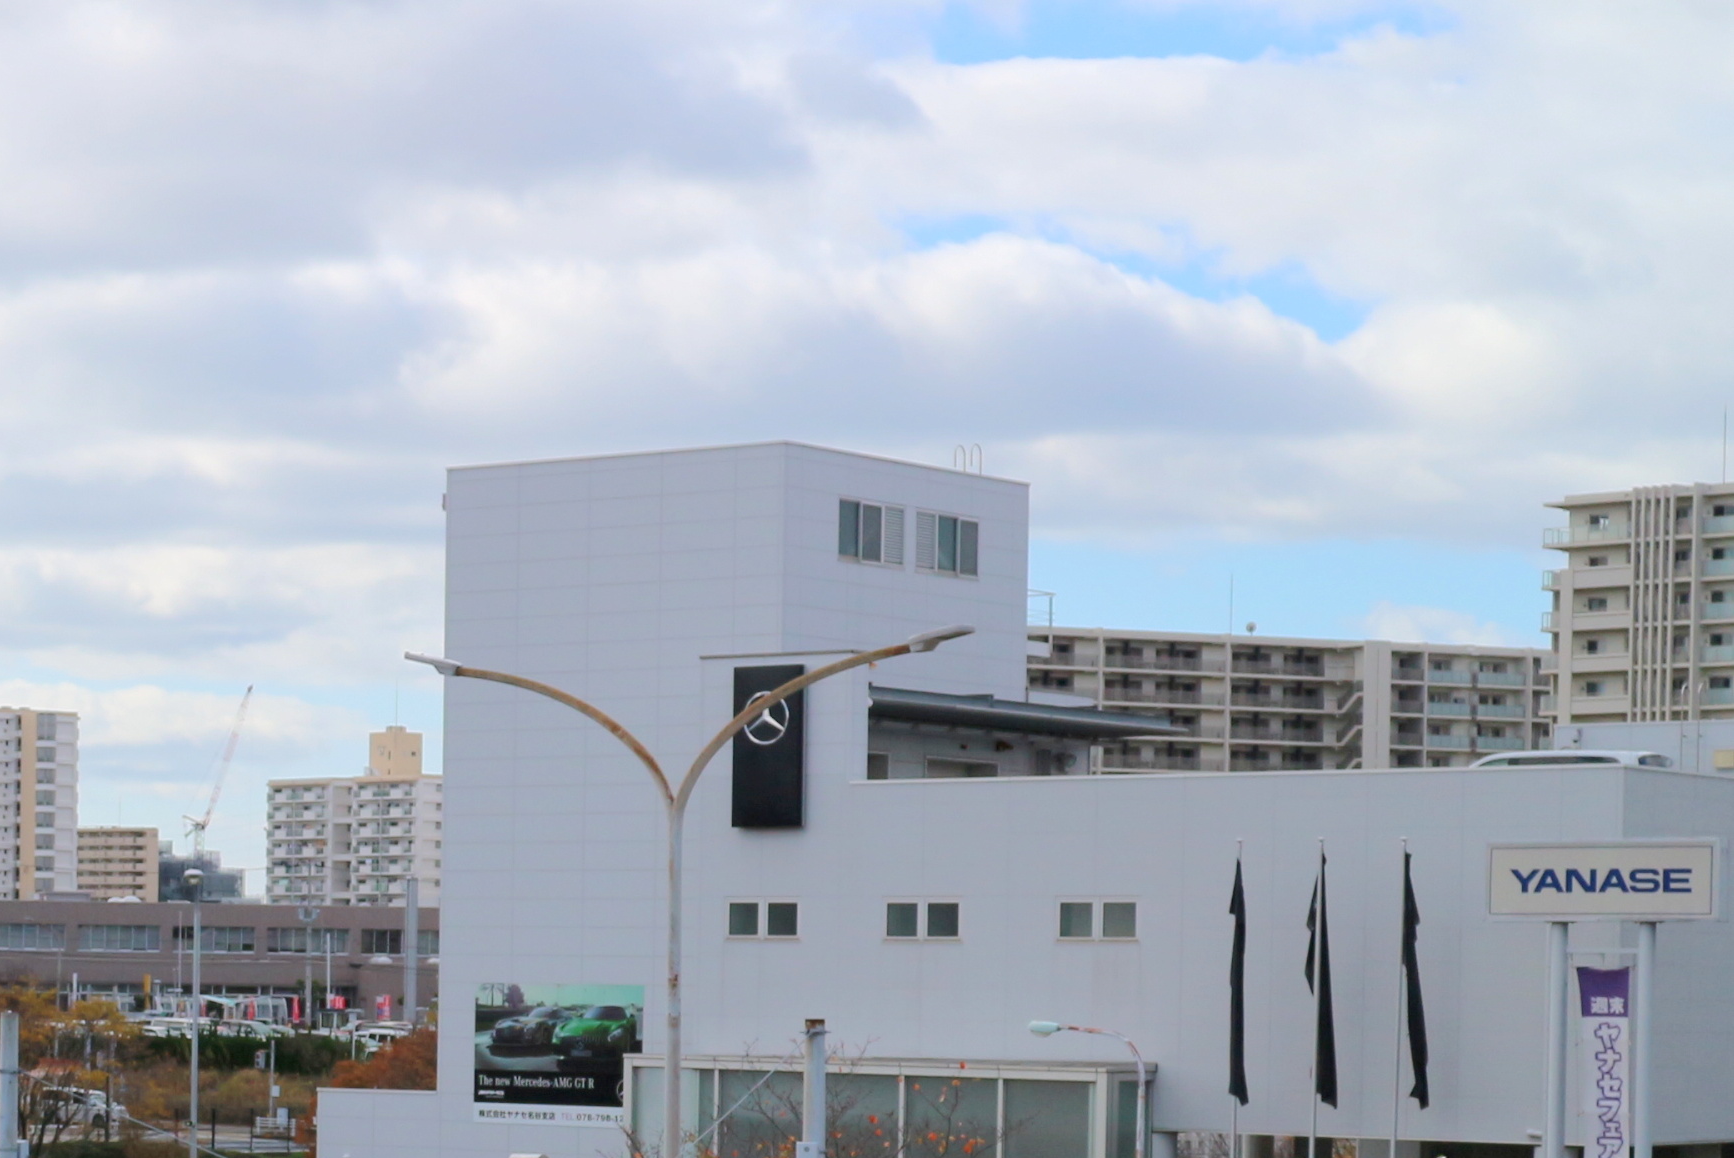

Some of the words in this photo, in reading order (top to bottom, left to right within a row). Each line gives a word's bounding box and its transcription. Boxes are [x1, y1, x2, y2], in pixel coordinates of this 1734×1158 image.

[1510, 868, 1693, 894] YANASE
[1591, 996, 1625, 1015] 週末
[478, 1075, 493, 1087] The
[495, 1078, 511, 1087] new
[513, 1075, 572, 1089] Mercedes-AMG
[574, 1078, 586, 1089] GT
[588, 1078, 595, 1090] R
